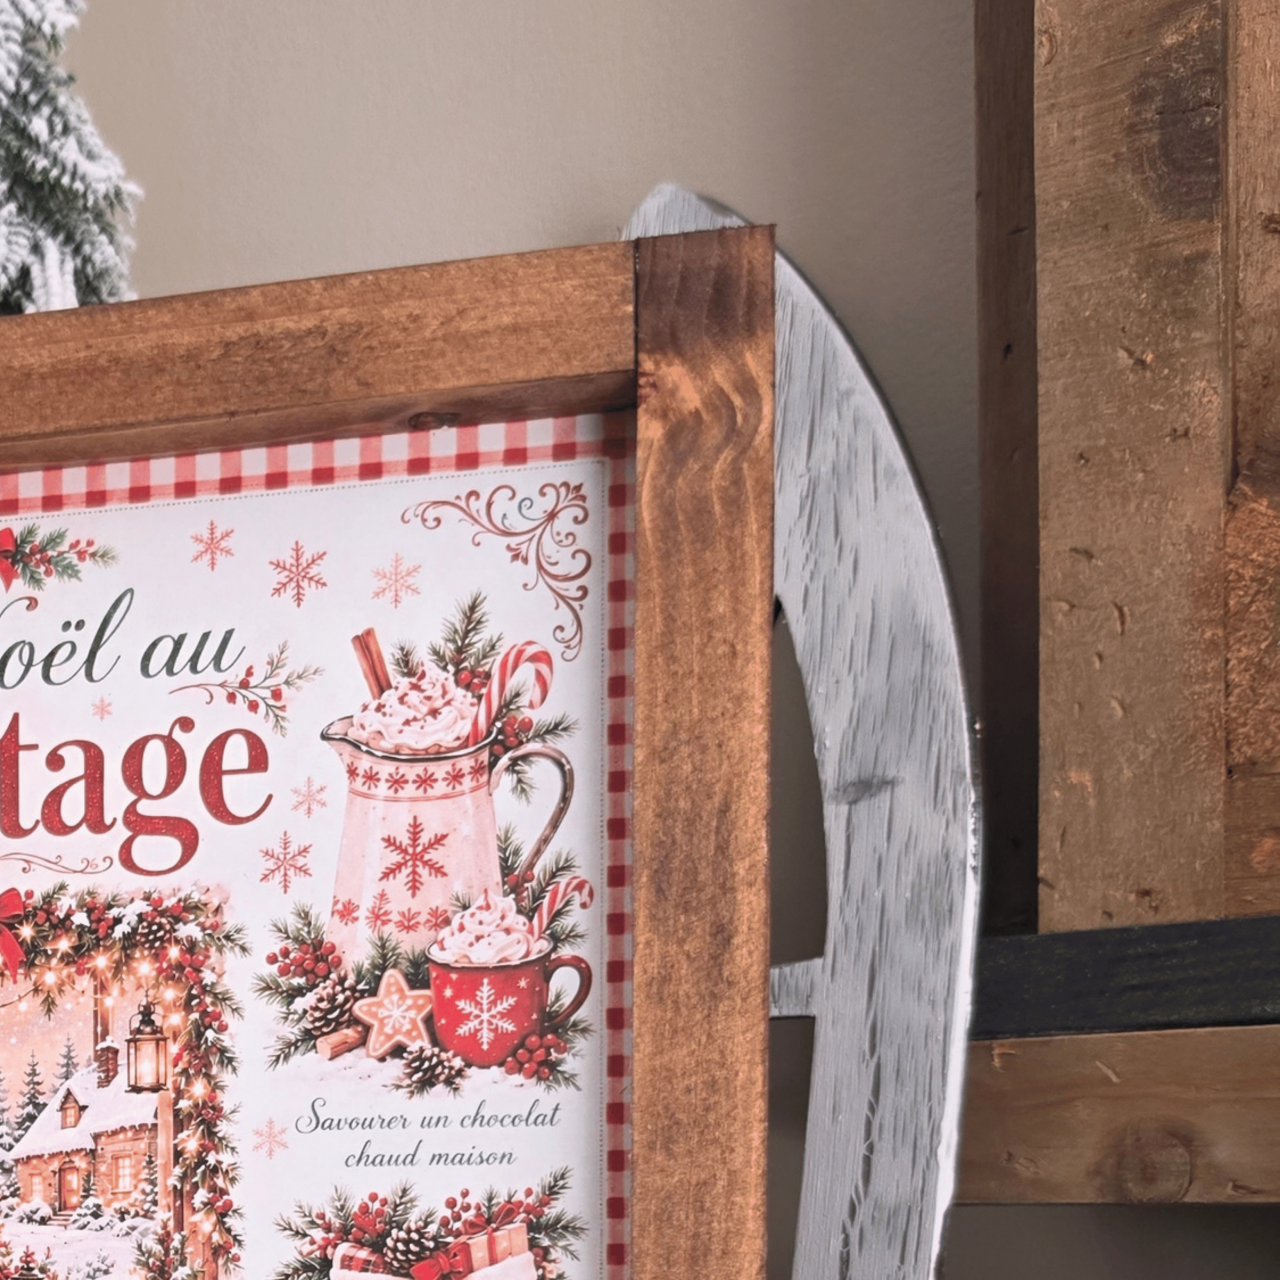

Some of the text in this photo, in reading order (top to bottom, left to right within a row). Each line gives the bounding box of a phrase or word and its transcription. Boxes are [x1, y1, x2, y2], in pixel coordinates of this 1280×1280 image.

[139, 627, 246, 679] au
[295, 1097, 562, 1134] Savourer un chocolat
[344, 1140, 518, 1168] chaud maison
